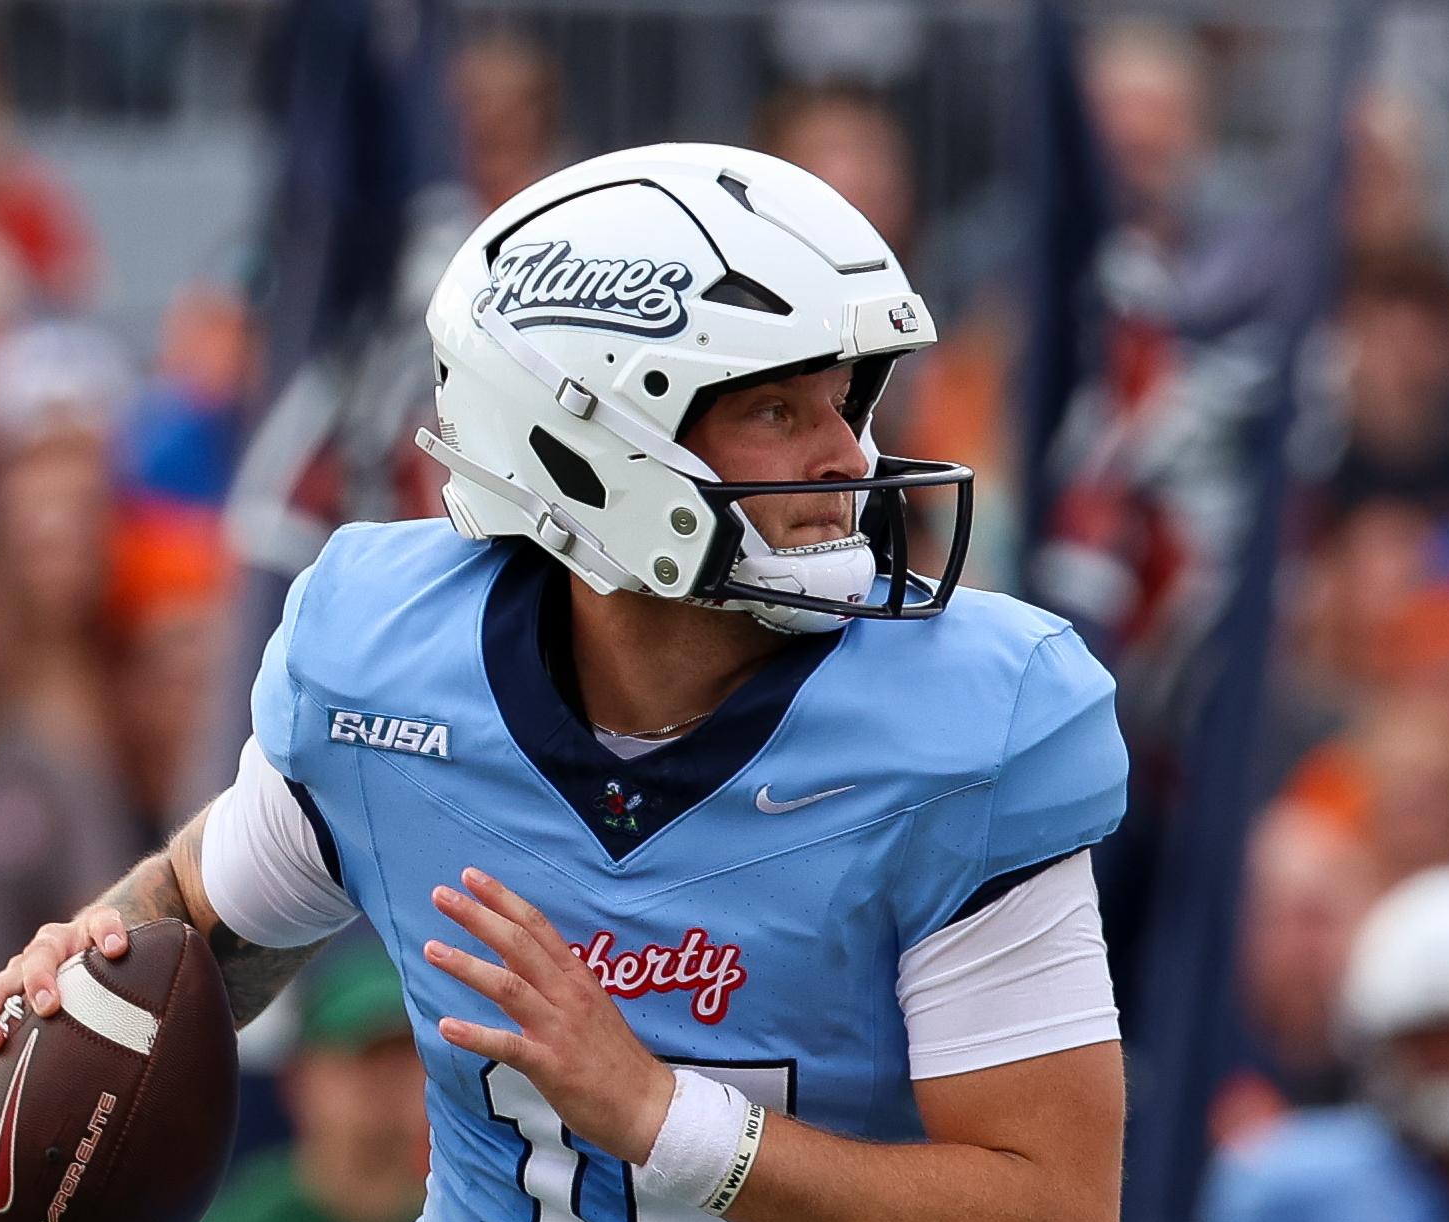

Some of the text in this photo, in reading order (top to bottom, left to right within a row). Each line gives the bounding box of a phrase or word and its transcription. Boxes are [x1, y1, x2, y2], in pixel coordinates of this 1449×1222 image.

[472, 240, 693, 338] Flames
[569, 928, 747, 1025] berty
[76, 1091, 117, 1163] ELITE
[725, 1152, 751, 1189] WILL
[745, 1119, 759, 1140] NO
